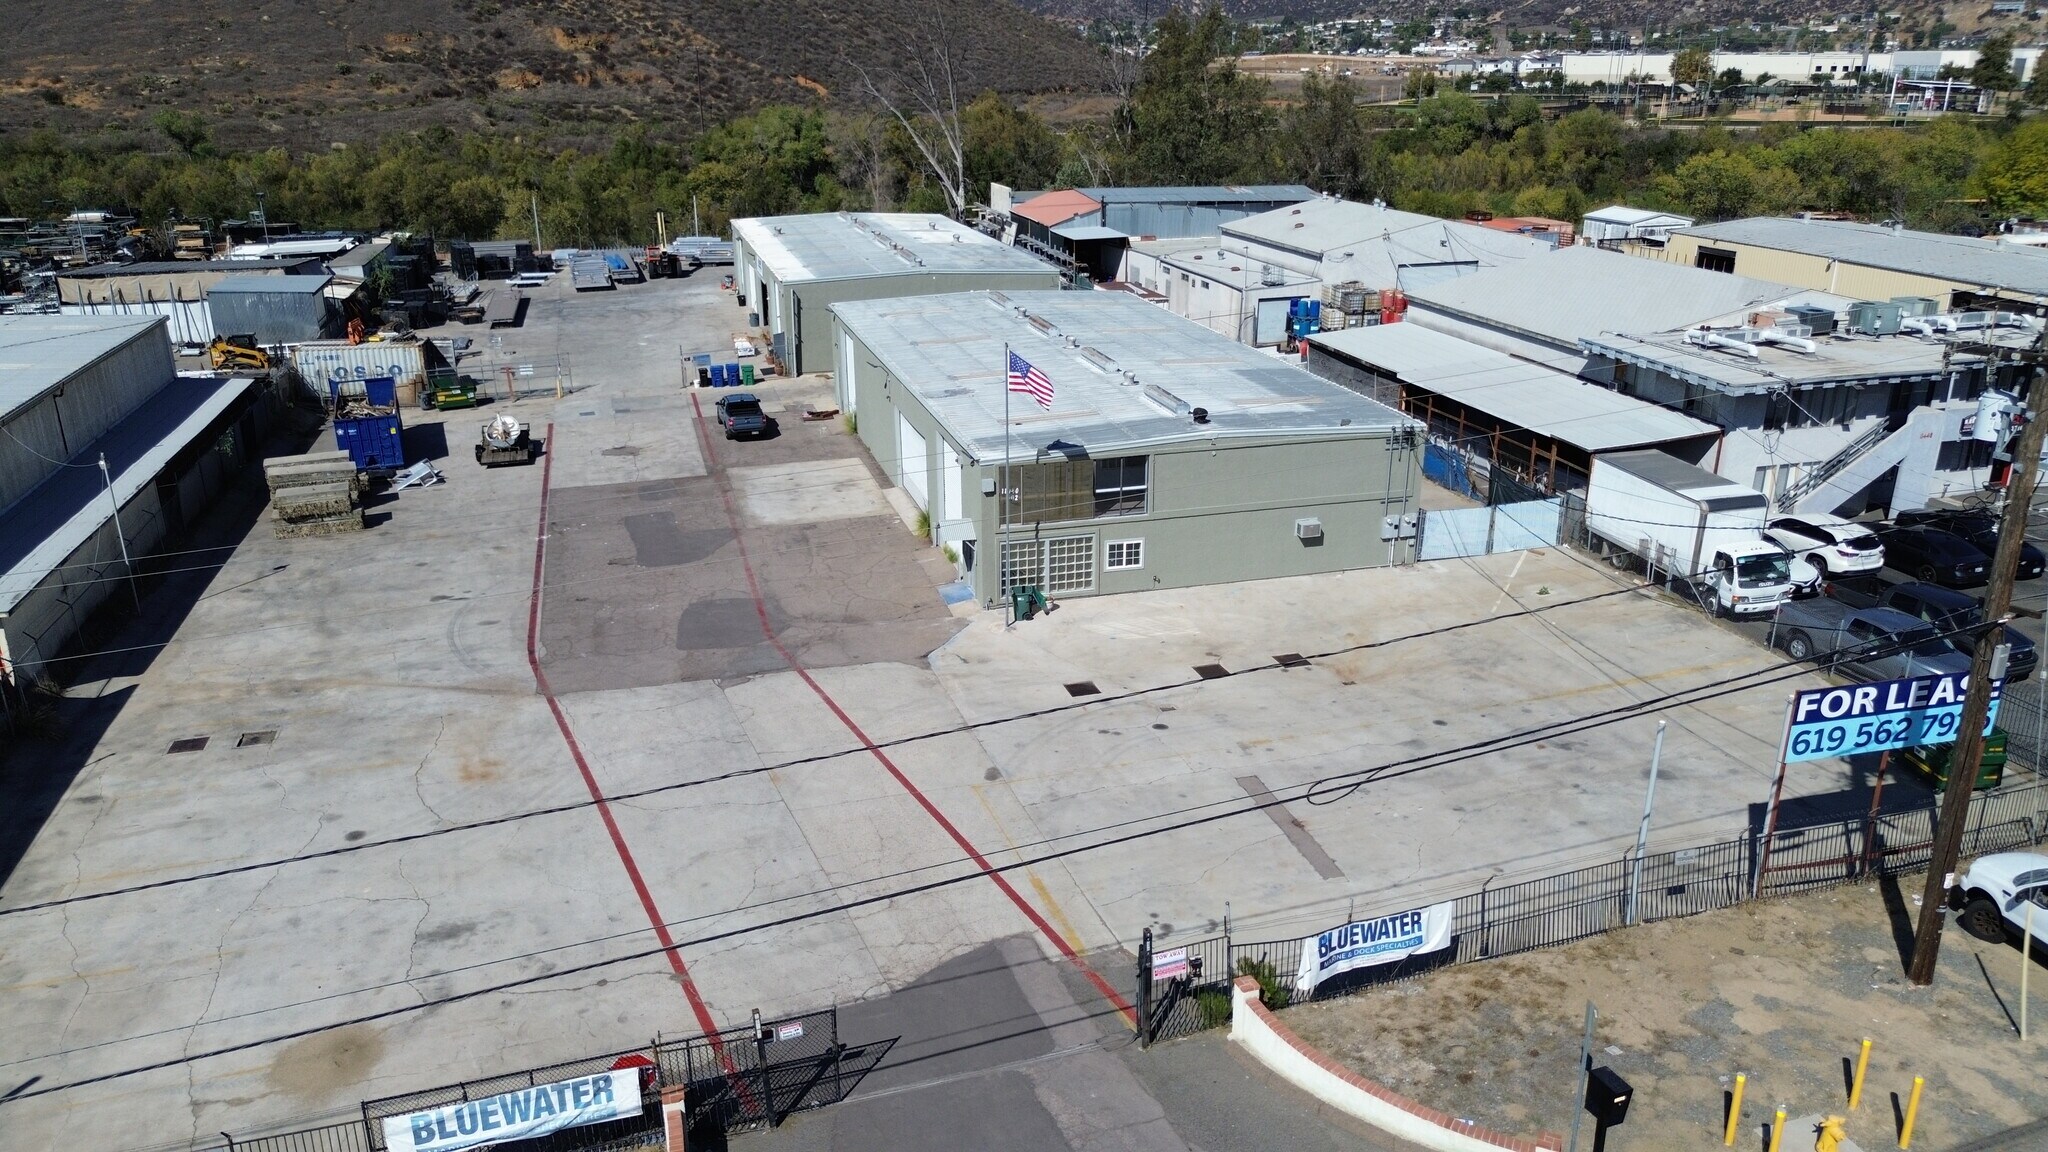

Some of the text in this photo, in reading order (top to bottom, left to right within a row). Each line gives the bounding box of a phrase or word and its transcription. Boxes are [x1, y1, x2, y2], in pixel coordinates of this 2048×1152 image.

[1796, 686, 1878, 723] FOR
[1791, 726, 1846, 756] 619
[1853, 717, 1912, 748] 562
[1317, 911, 1422, 959] BLUEWATER
[1323, 951, 1346, 968] MARINE
[1354, 946, 1375, 957] DOCK
[1376, 938, 1419, 952] SPECIALTIES
[1155, 949, 1184, 961] TOW AWAY
[410, 1074, 615, 1146] BLUEWATER
